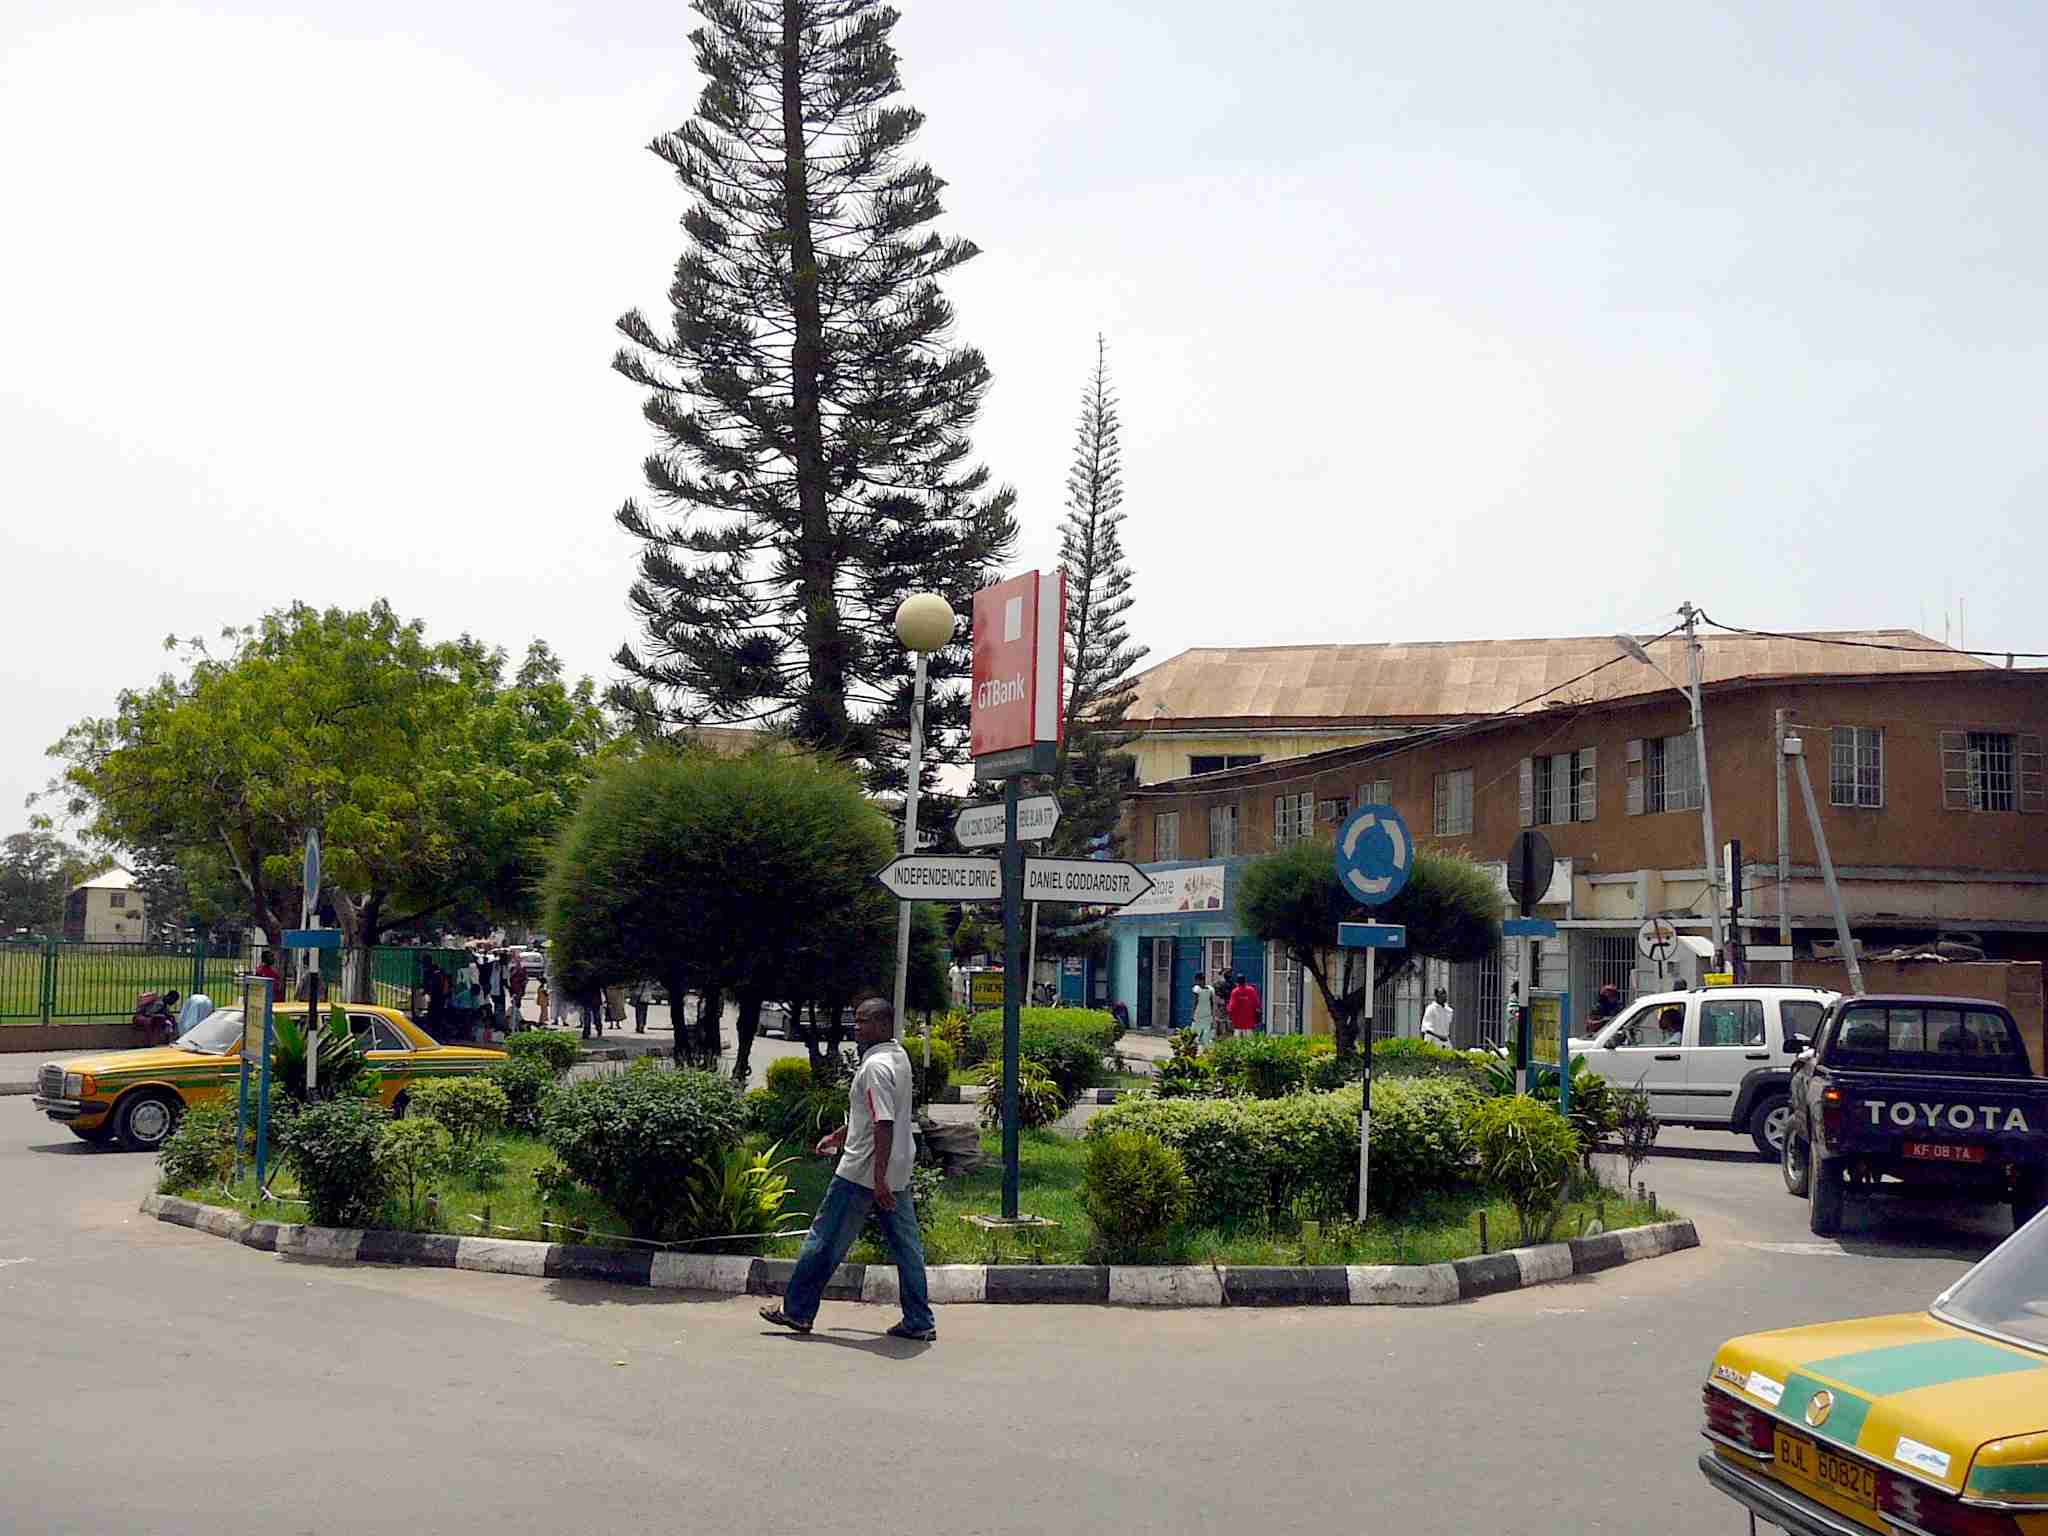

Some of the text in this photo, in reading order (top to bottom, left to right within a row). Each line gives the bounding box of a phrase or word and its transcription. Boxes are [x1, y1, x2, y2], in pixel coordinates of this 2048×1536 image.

[977, 672, 1025, 709] GTBank
[894, 867, 997, 888] INDEPENDENCE DRIVE
[1029, 871, 1063, 889] DANIEL
[1864, 1100, 2029, 1132] TOYOTA
[1781, 1439, 1808, 1473] BJL
